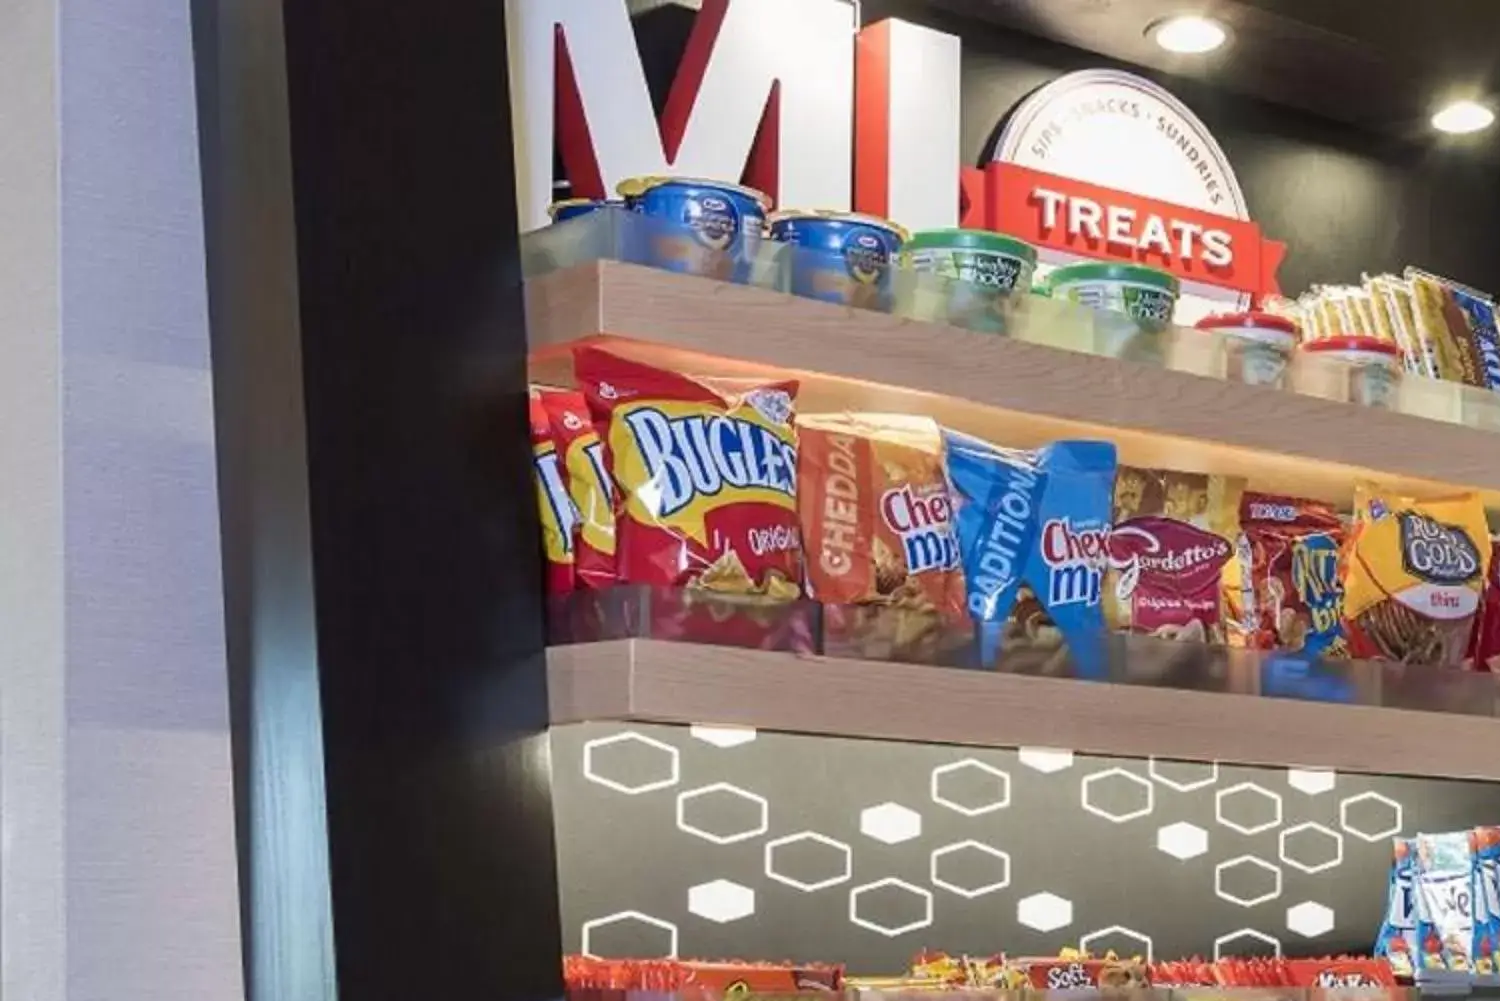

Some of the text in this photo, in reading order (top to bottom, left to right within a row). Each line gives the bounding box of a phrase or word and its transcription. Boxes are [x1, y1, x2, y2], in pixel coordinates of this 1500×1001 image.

[1156, 115, 1225, 206] SUNDRIES
[1033, 187, 1234, 267] TREATS
[1047, 962, 1089, 991] Soft
